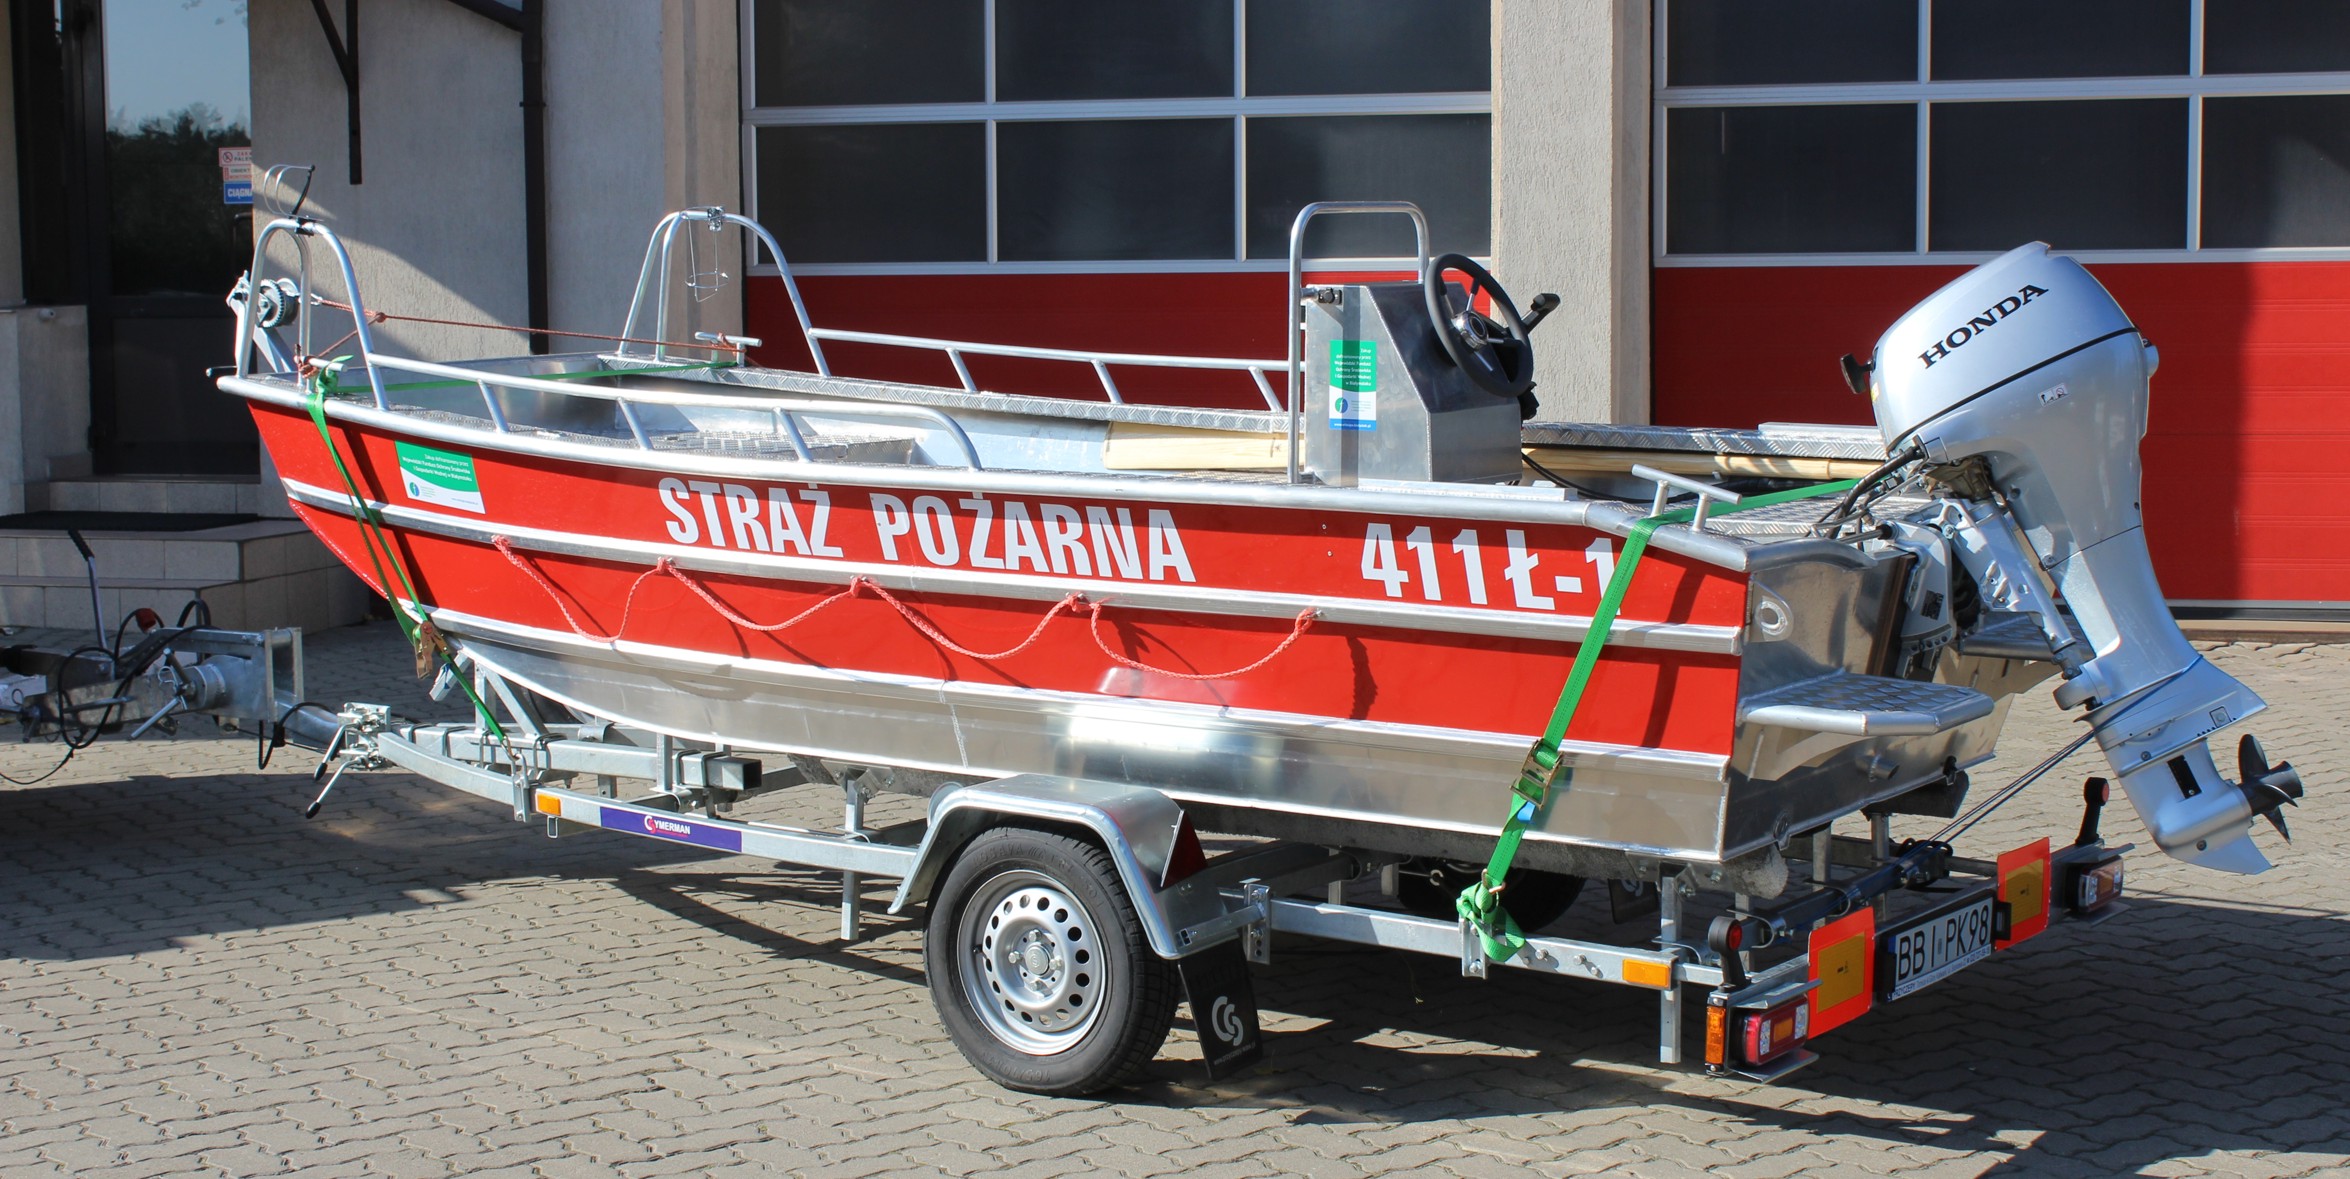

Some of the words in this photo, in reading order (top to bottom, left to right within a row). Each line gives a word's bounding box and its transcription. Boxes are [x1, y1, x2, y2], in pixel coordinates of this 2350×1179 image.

[1918, 284, 2049, 369] HONDA
[658, 477, 843, 558] STRAŻ
[870, 491, 1196, 583] POŻARNA
